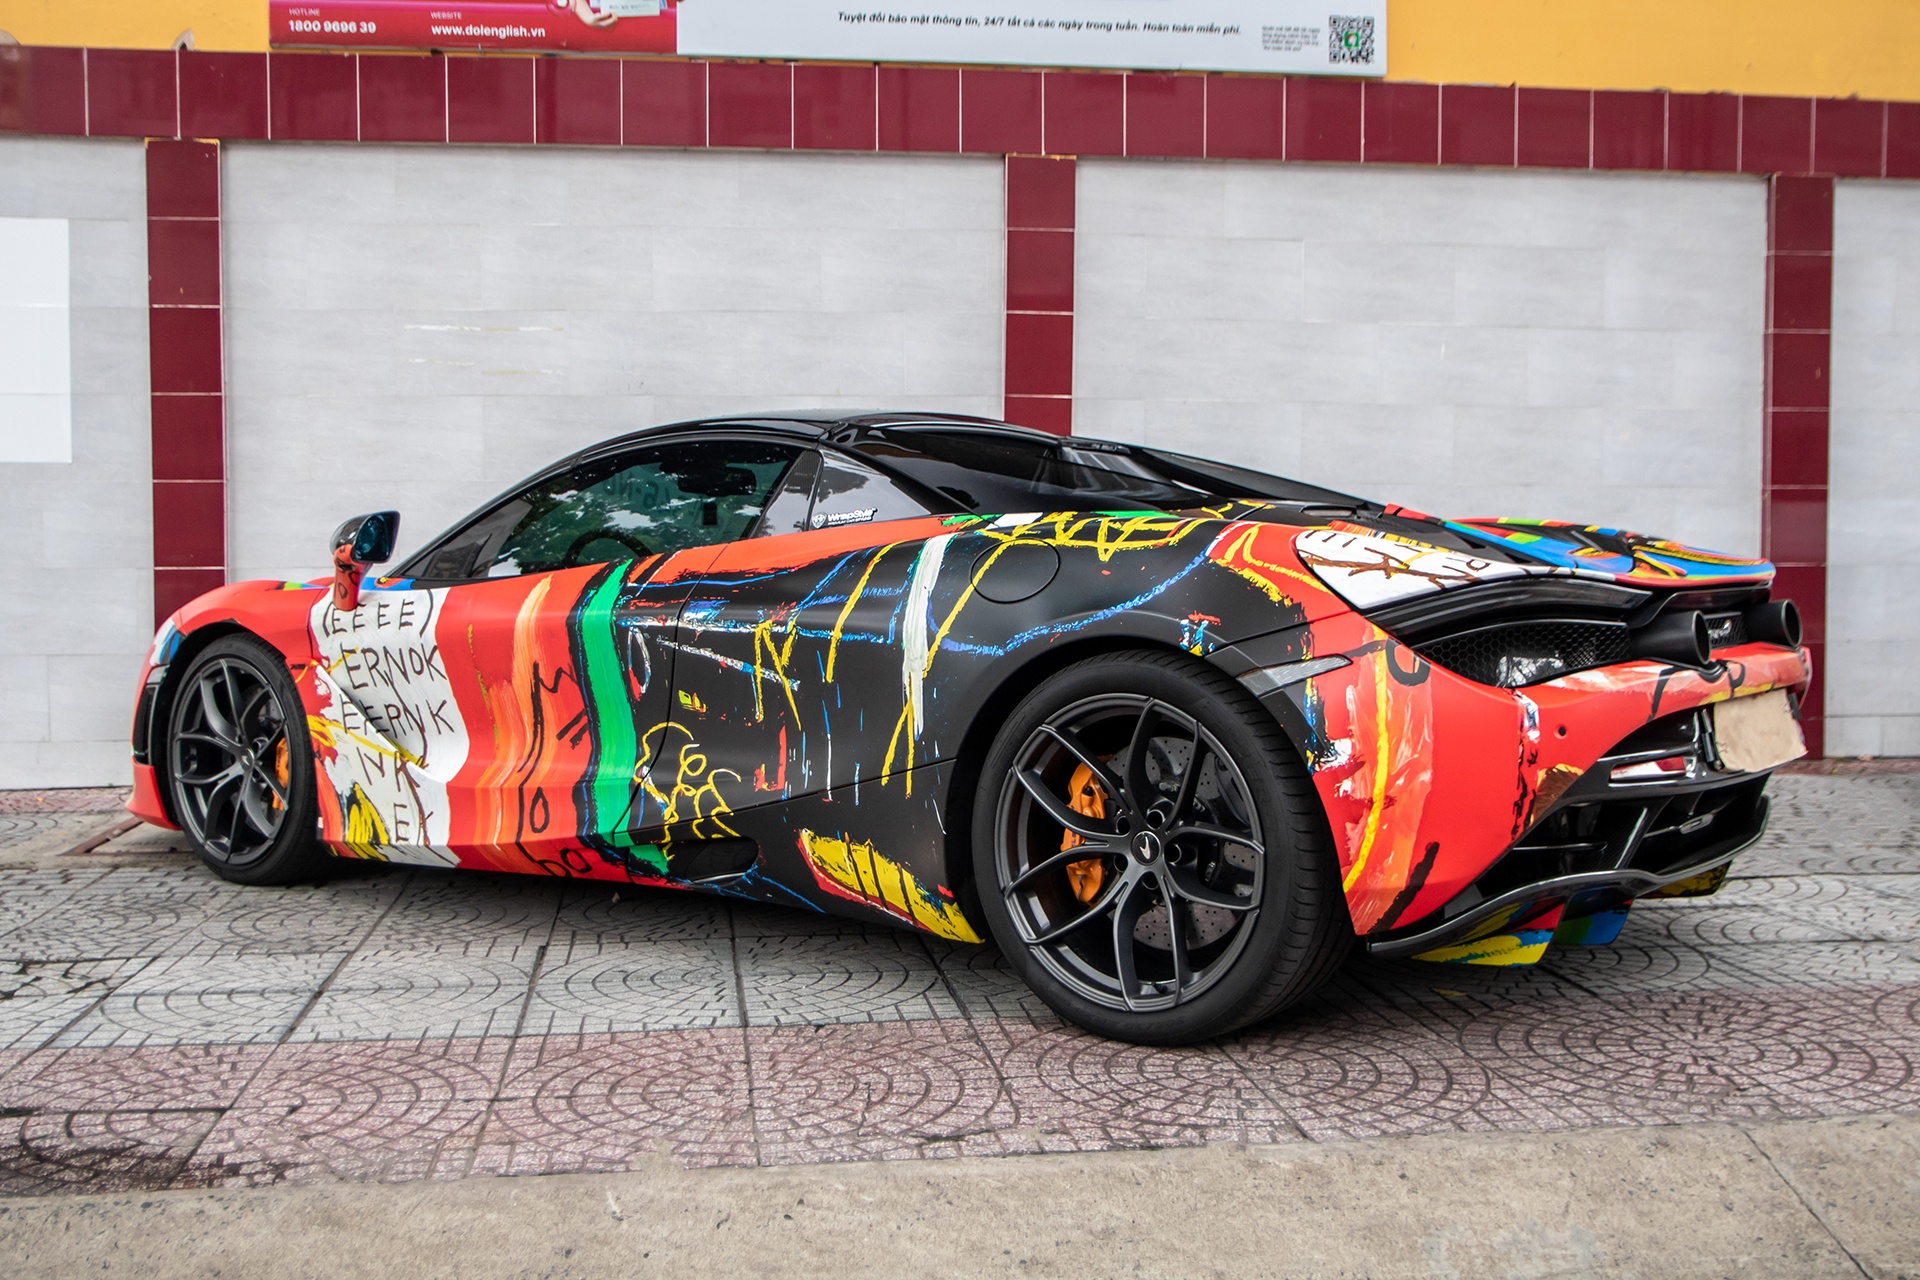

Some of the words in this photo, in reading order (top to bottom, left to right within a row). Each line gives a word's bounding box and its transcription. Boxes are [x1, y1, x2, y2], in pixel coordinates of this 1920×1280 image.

[288, 7, 321, 17] HOTLINE
[430, 11, 462, 20] WEBSITE
[288, 20, 321, 32] 1800
[838, 11, 867, 24] Tuyệt
[888, 13, 908, 24] bảo
[910, 14, 930, 26] mật
[932, 14, 962, 27] thông
[965, 15, 980, 27] tin,
[984, 16, 1005, 27] 24/7
[1038, 18, 1055, 29] các
[1058, 19, 1083, 32] ngày
[1086, 20, 1113, 33] trong
[1143, 21, 1169, 32] Hoàn
[1172, 22, 1194, 34] toàn
[431, 24, 546, 39] www.dolenglish.vn
[828, 509, 873, 521] WrapStyle
[340, 642, 448, 690] ERNOK
